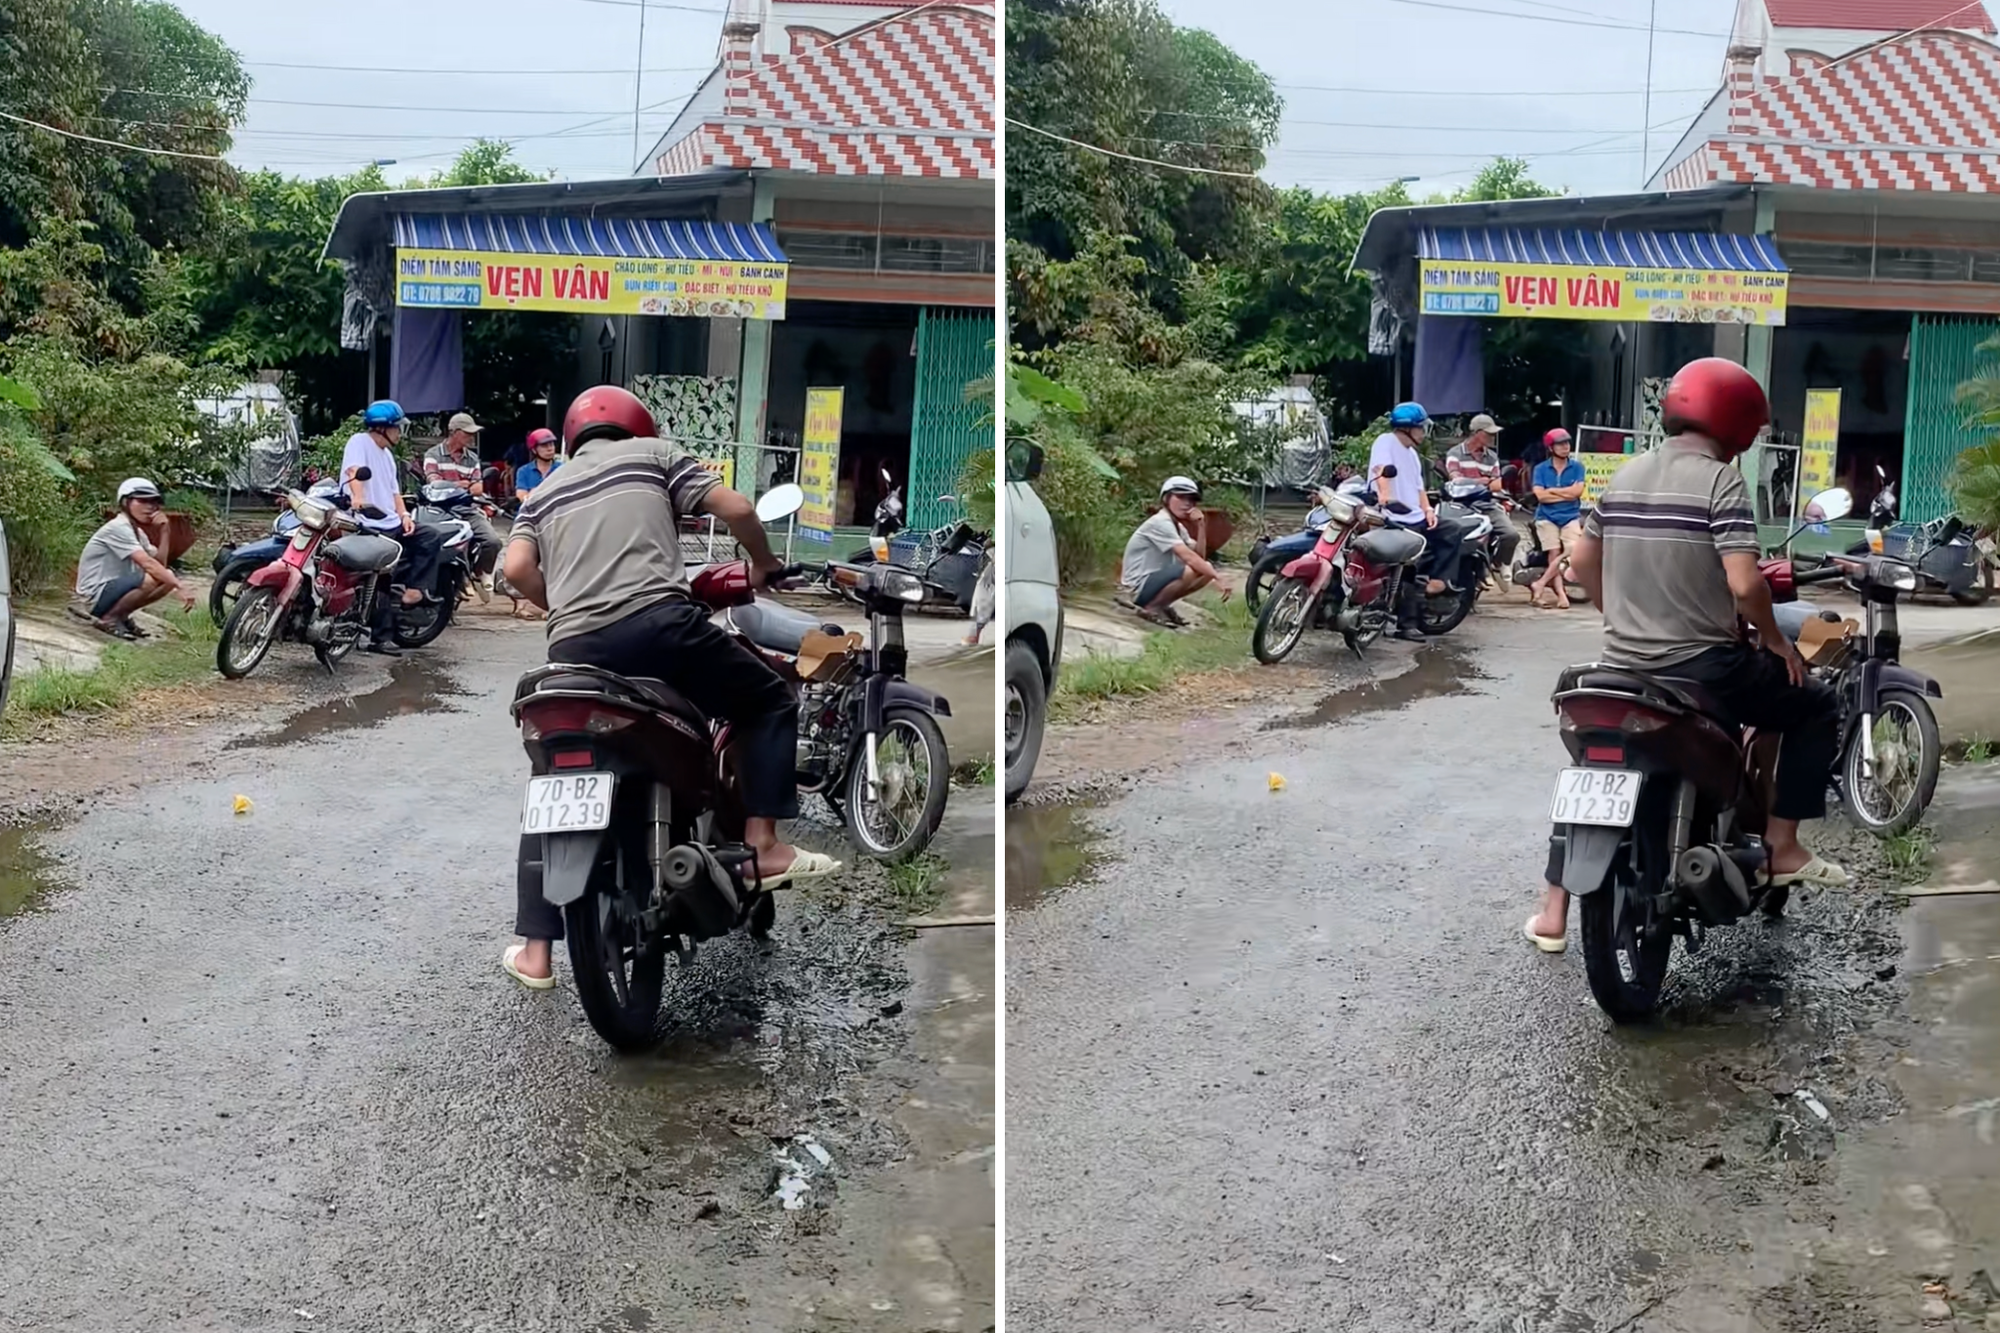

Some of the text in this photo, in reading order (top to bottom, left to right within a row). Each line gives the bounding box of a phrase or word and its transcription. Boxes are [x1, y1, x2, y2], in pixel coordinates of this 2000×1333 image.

[487, 263, 610, 303] VẸN VÂN
[764, 268, 784, 279] CANH
[1505, 273, 1620, 310] VẸN VÂN
[539, 777, 598, 803] 70-B2
[1569, 772, 1627, 795] 70-B2
[528, 802, 604, 829] 012.39
[1555, 797, 1630, 821] 012.39
